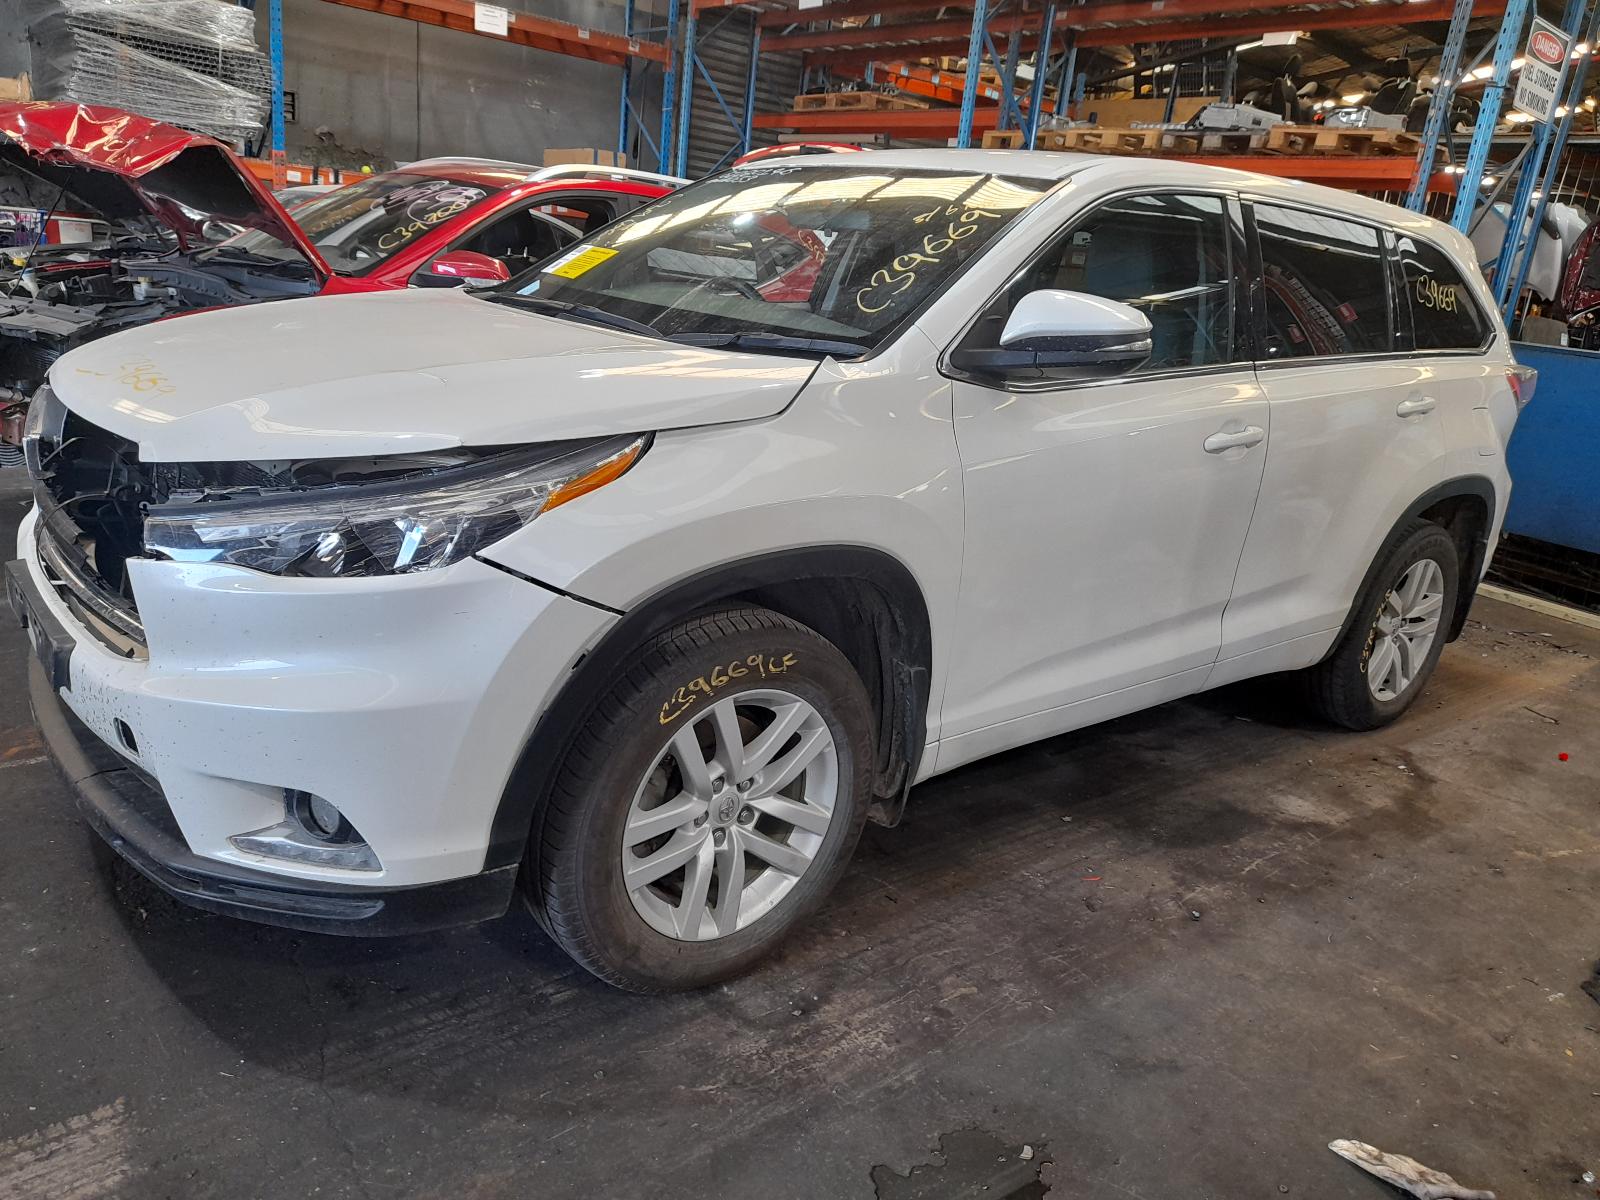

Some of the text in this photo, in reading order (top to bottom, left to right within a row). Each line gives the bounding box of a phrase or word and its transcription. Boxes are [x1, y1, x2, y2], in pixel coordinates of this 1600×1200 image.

[1535, 34, 1560, 60] DANGER
[1522, 63, 1557, 93] FUEL STORAGE
[1519, 87, 1549, 115] NO SMOKING
[856, 210, 1002, 313] C39669
[1416, 274, 1458, 315] C39669
